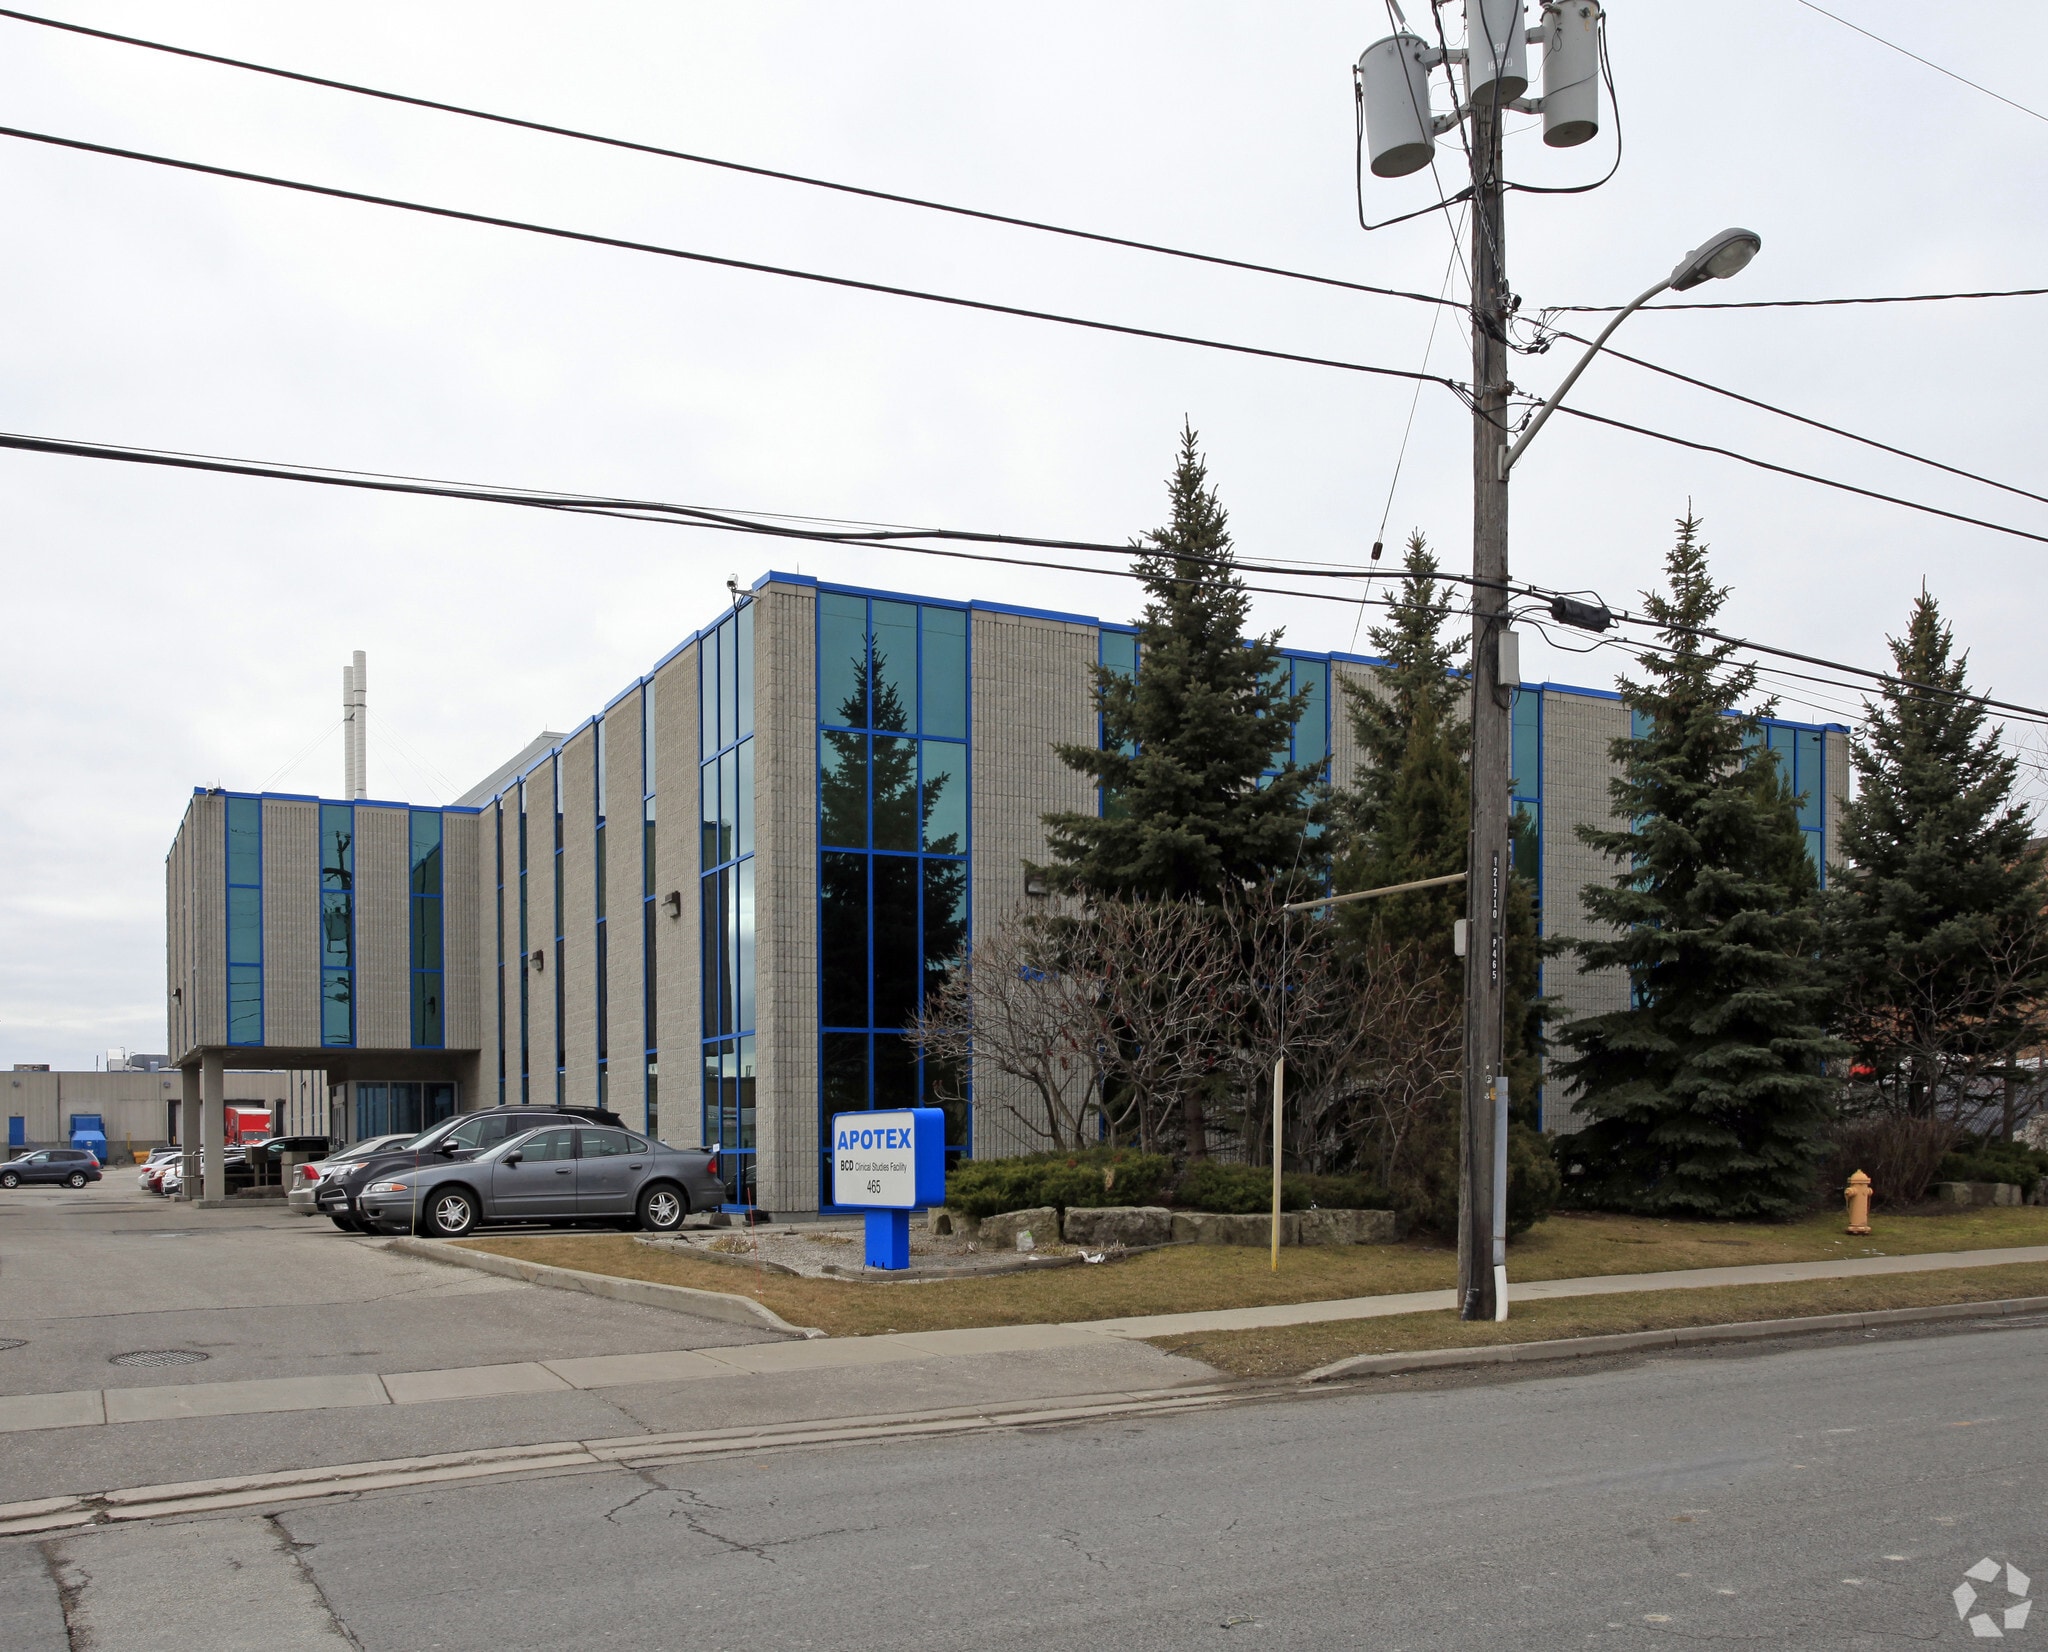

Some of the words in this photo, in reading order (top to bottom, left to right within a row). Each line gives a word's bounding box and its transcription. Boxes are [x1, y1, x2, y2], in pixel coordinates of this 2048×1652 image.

[1494, 43, 1506, 53] 50
[837, 1128, 912, 1150] APOTEX
[840, 1160, 854, 1171] BCD
[855, 1162, 871, 1171] Clinical
[872, 1162, 889, 1171] Studies
[890, 1162, 907, 1174] Facility
[867, 1179, 881, 1193] 465
